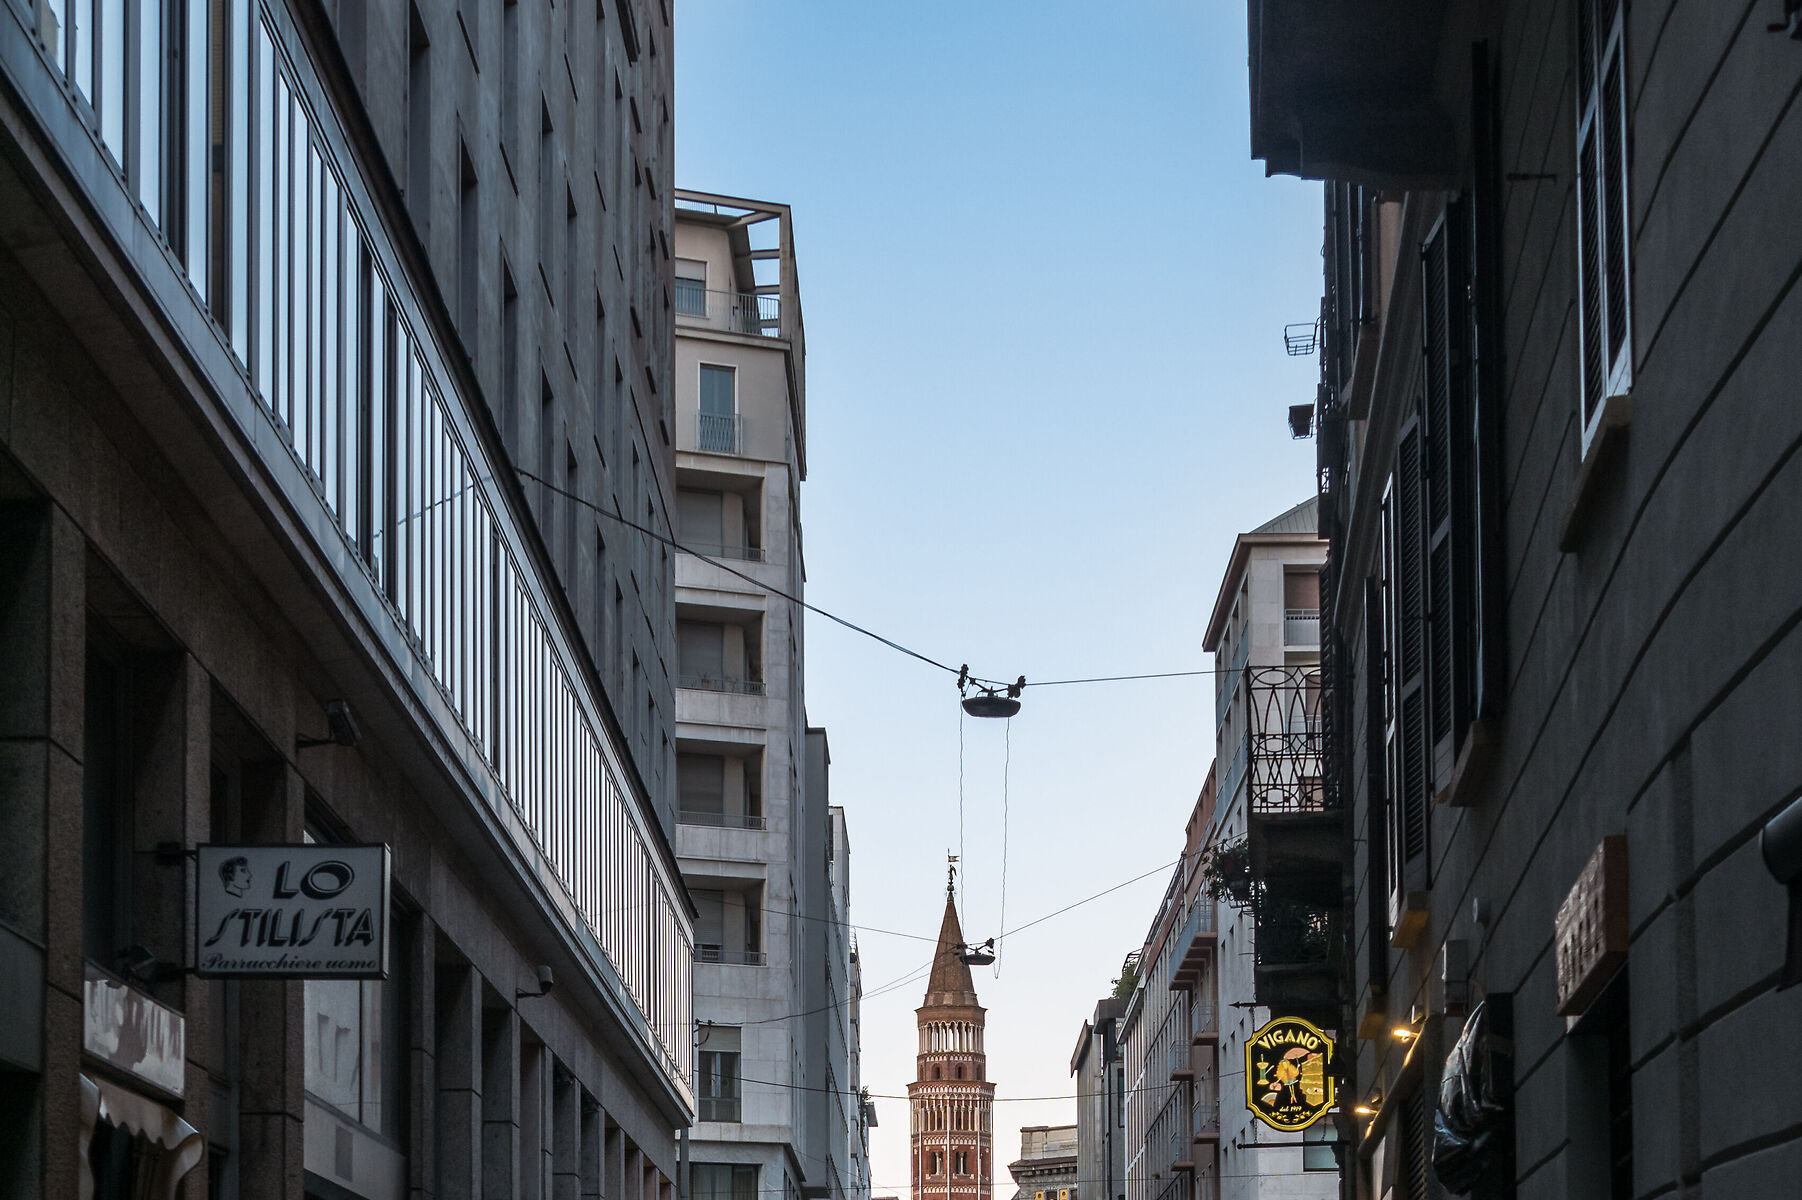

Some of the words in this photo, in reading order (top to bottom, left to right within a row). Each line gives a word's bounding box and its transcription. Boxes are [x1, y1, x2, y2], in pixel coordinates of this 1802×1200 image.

[272, 860, 355, 900] LO
[204, 908, 375, 947] STILISTA
[202, 953, 322, 970] Parrucchiere
[326, 959, 377, 970] uomo
